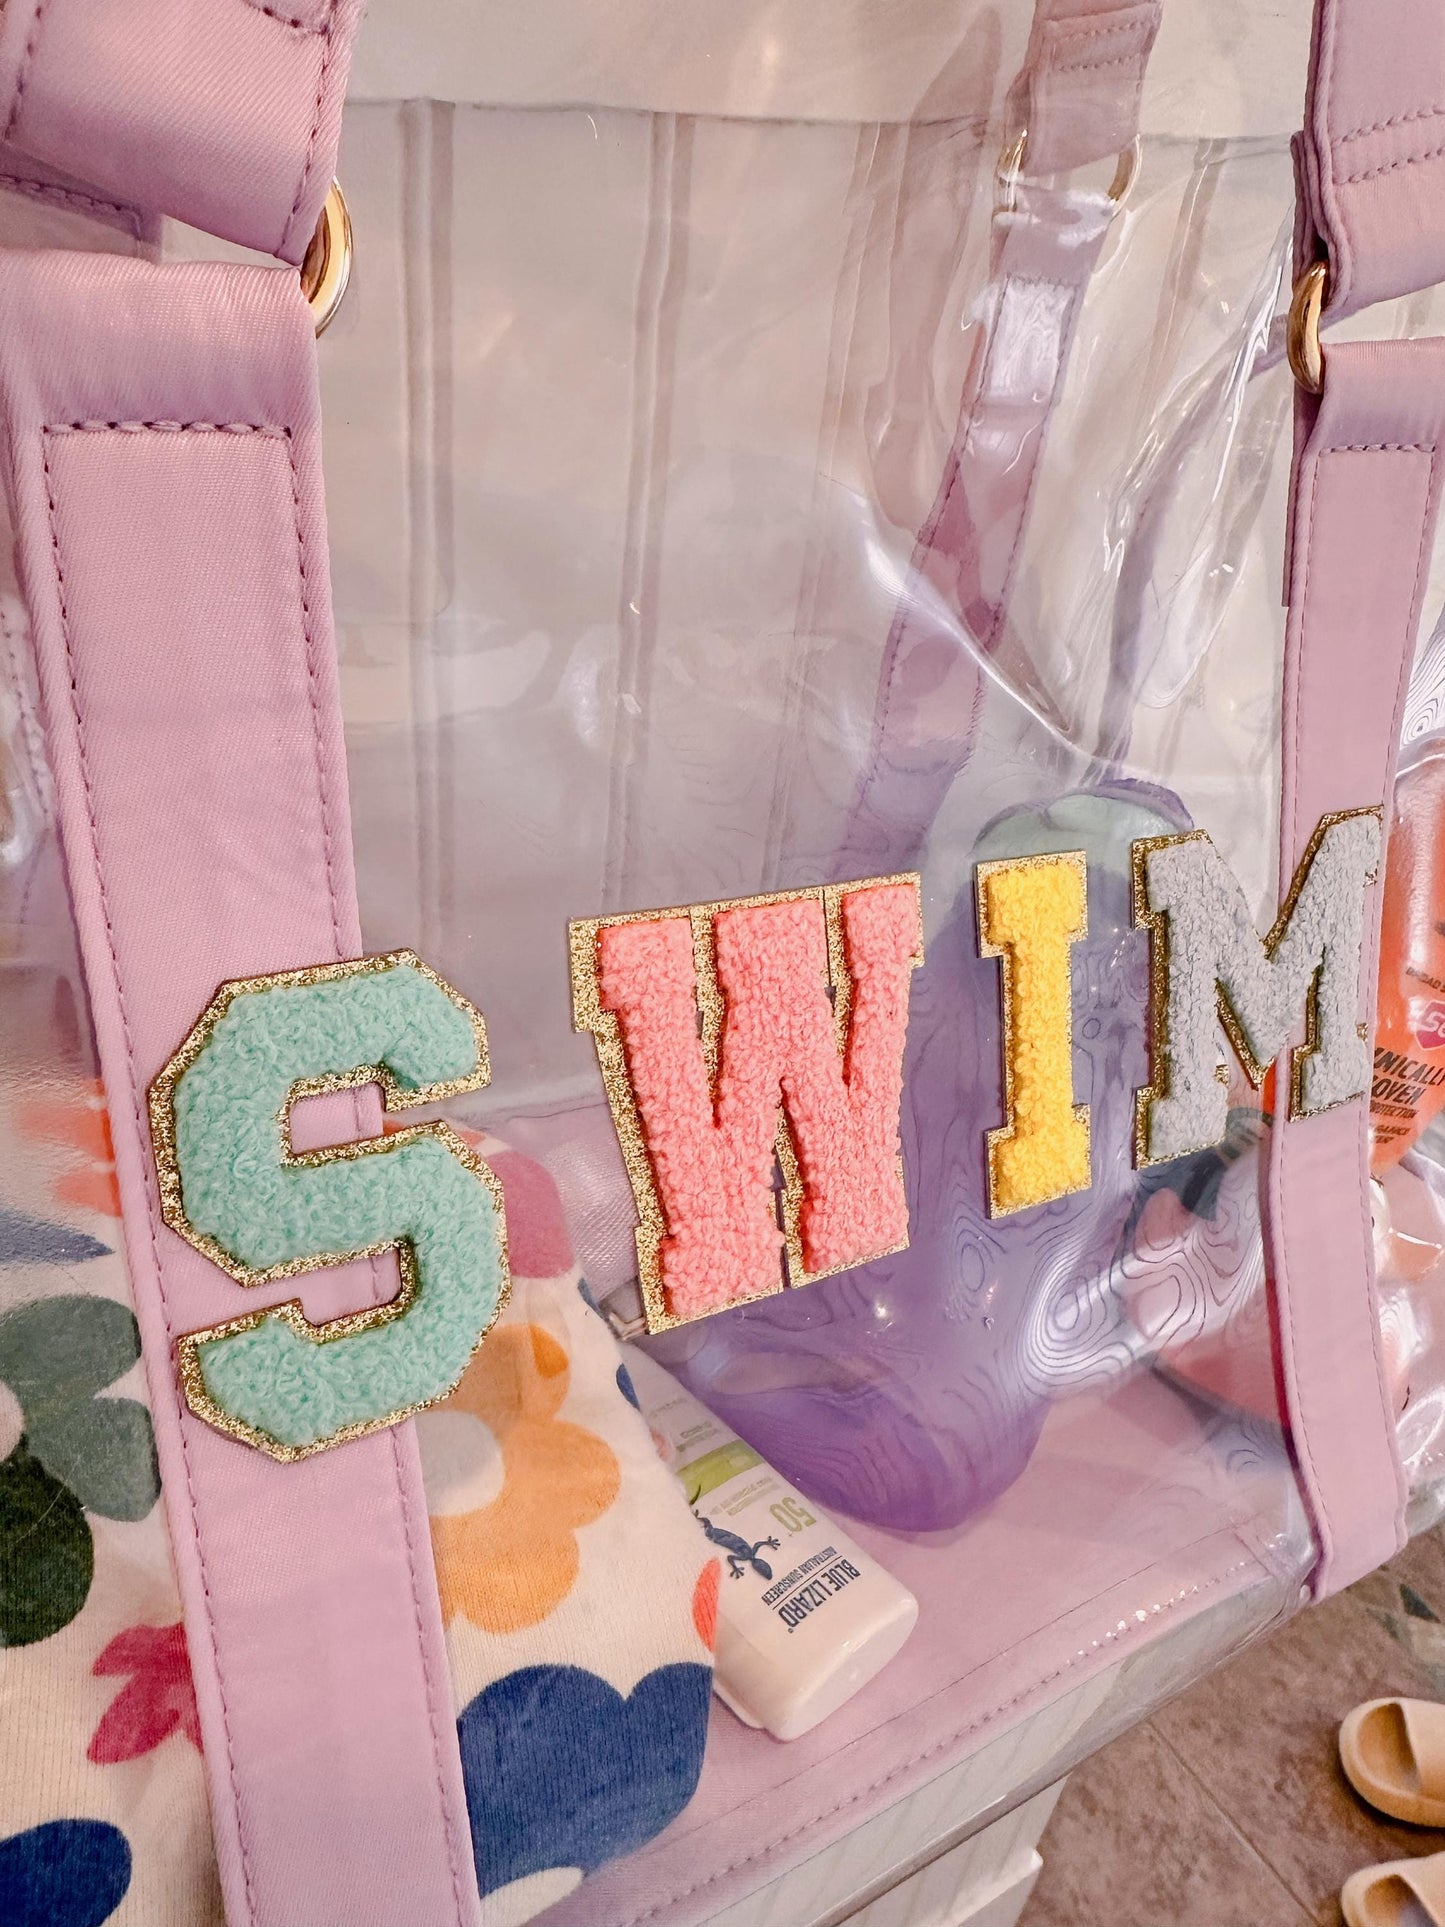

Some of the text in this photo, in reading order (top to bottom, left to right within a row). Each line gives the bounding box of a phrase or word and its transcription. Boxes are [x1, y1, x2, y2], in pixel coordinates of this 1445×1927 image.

[1372, 1075, 1427, 1105] OVEN
[148, 806, 1386, 1464] SWIM
[761, 1546, 837, 1606] AUSTRALIAN SUNSCREEN
[821, 1559, 861, 1591] BLUE
